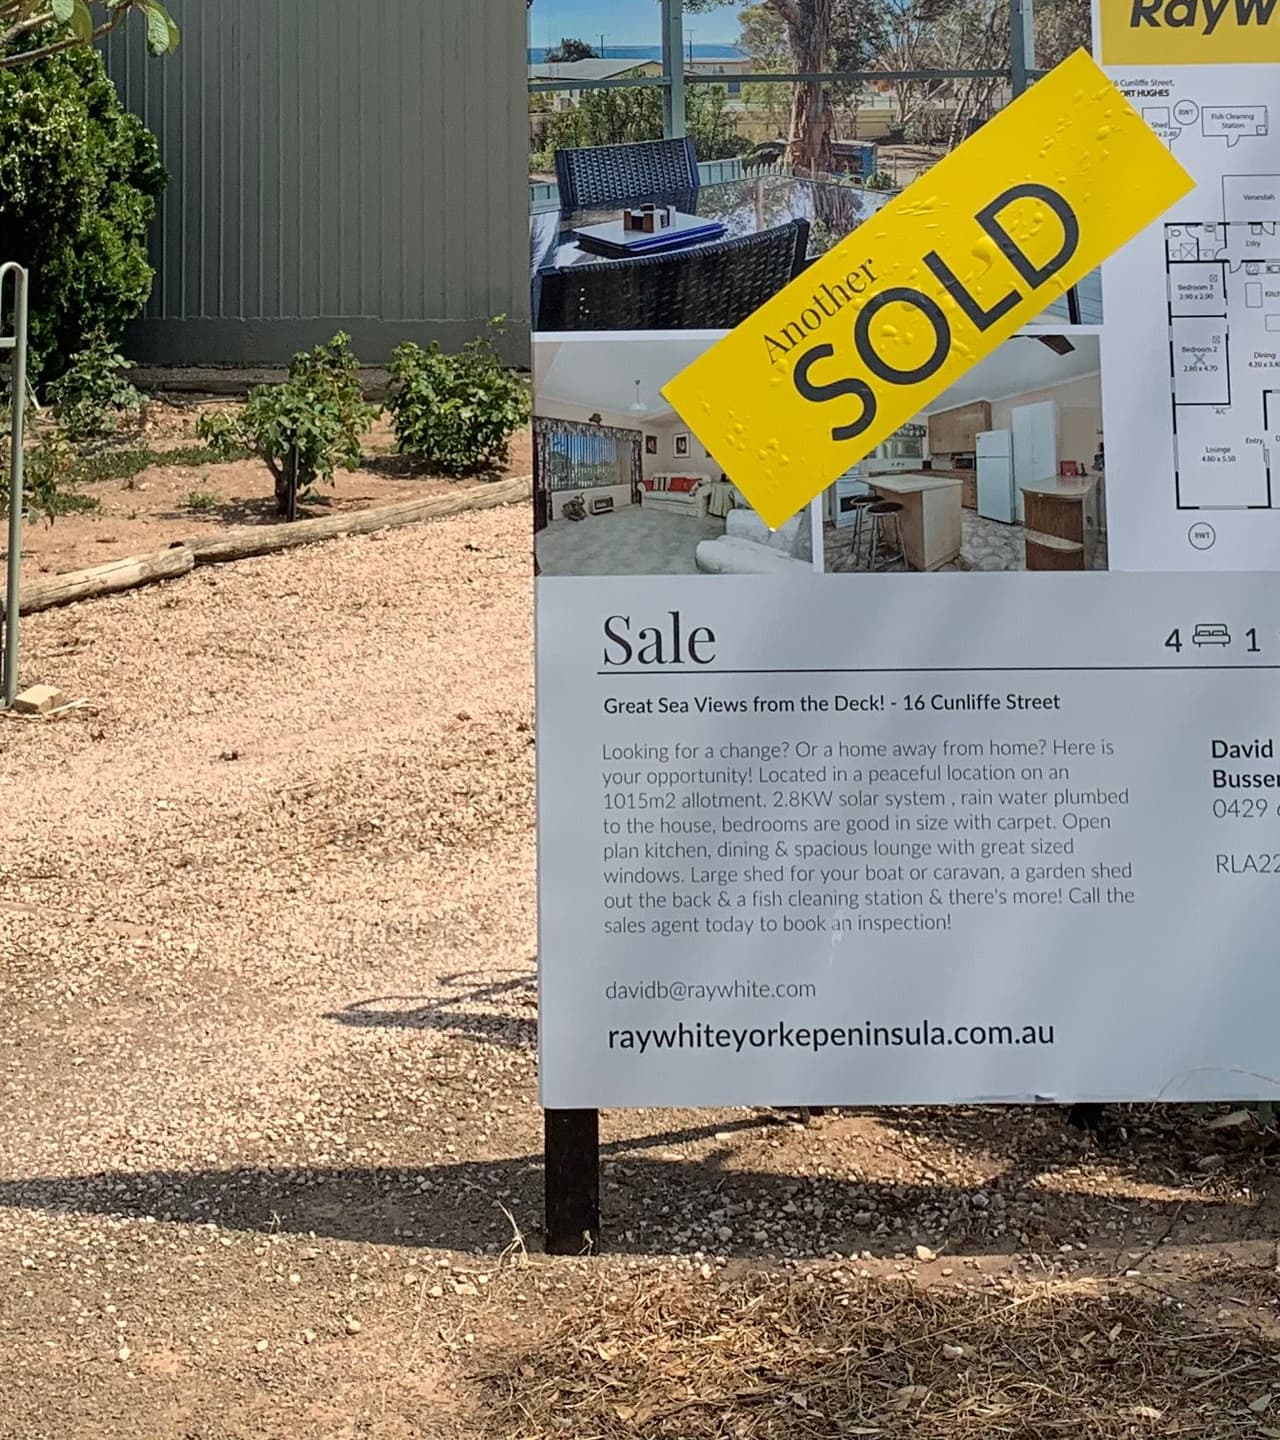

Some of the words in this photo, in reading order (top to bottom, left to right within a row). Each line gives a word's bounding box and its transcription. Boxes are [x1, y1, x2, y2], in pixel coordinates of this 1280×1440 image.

[1137, 88, 1170, 97] HUGHES
[761, 258, 880, 366] Another
[793, 183, 1080, 441] SOLD
[603, 610, 716, 665] Sale
[1164, 628, 1183, 653] 4
[1245, 627, 1261, 652] 1
[603, 697, 653, 714] Great
[657, 696, 689, 713] Sea
[693, 695, 748, 712] Views
[752, 695, 795, 712] from
[799, 694, 829, 712] the
[834, 693, 884, 711] Deck!
[903, 693, 925, 711] 16
[930, 692, 1001, 710] Cunliffe
[1006, 693, 1060, 710] Street
[602, 741, 669, 763] Looking
[674, 741, 700, 759] for
[704, 746, 714, 759] a
[719, 740, 790, 762] change?
[795, 740, 818, 758] Or
[823, 744, 832, 757] a
[838, 739, 887, 757] home
[892, 743, 937, 760] away
[943, 738, 983, 756] from
[989, 738, 1047, 756] home?
[1053, 738, 1095, 756] Here
[1100, 737, 1114, 755] is
[1211, 737, 1273, 759] David
[601, 771, 642, 788] your
[646, 765, 752, 788] opportunity!
[759, 764, 826, 783] Located
[832, 764, 847, 782] in
[852, 769, 862, 782] a
[868, 763, 941, 785] peaceful
[946, 763, 1015, 781] location
[1020, 767, 1042, 780] on
[1048, 767, 1069, 780] an
[603, 791, 676, 809] 1015m2
[681, 791, 766, 808] allotment.
[772, 789, 833, 808] 2.8KW
[838, 789, 880, 808] solar
[884, 789, 945, 810] system
[961, 788, 992, 805] rain
[997, 789, 1048, 805] water
[1054, 786, 1128, 808] plumbed
[1212, 798, 1268, 818] 0429
[603, 818, 620, 834] to
[626, 816, 654, 834] the
[660, 816, 715, 835] house,
[722, 815, 808, 832] bedrooms
[813, 819, 840, 832] are
[846, 813, 889, 835] good
[895, 813, 910, 830] in
[916, 813, 948, 830] size
[953, 812, 991, 830] with
[997, 813, 1056, 832] carpet.
[1062, 812, 1110, 832] Open
[603, 841, 639, 862] plan
[644, 839, 711, 860] kitchen,
[716, 839, 770, 861] dining
[774, 840, 789, 857] &
[794, 839, 868, 860] spacious
[873, 839, 932, 859] lounge
[936, 837, 975, 855] with
[980, 839, 1025, 859] great
[1030, 836, 1074, 854] sized
[603, 865, 684, 884] windows.
[690, 865, 737, 886] Large
[743, 864, 784, 882] shed
[790, 864, 816, 882] for
[819, 868, 860, 885] your
[865, 863, 904, 880] boat
[909, 867, 928, 880] or
[933, 866, 1004, 880] caravan,
[1010, 866, 1019, 880] a
[1025, 861, 1085, 883] garden
[1090, 860, 1132, 879] shed
[603, 892, 632, 909] out
[638, 891, 666, 911] the
[672, 890, 711, 908] back
[717, 889, 732, 907] &
[736, 894, 746, 907] a
[752, 889, 782, 908] fish
[788, 888, 859, 910] cleaning
[864, 887, 923, 906] station
[928, 887, 943, 905] &
[948, 887, 1007, 905] there's
[1012, 887, 1062, 904] more!
[1068, 886, 1100, 904] Call
[1106, 885, 1135, 904] the
[604, 916, 645, 933] sales
[651, 916, 699, 936] agent
[705, 914, 754, 935] today
[760, 916, 777, 932] to
[783, 913, 826, 931] book
[831, 918, 852, 931] an
[857, 913, 951, 934] inspection!
[605, 978, 816, 1002] davidb@raywhite.com
[608, 1018, 1054, 1054] raywhiteyorkepeninsula.com.au
